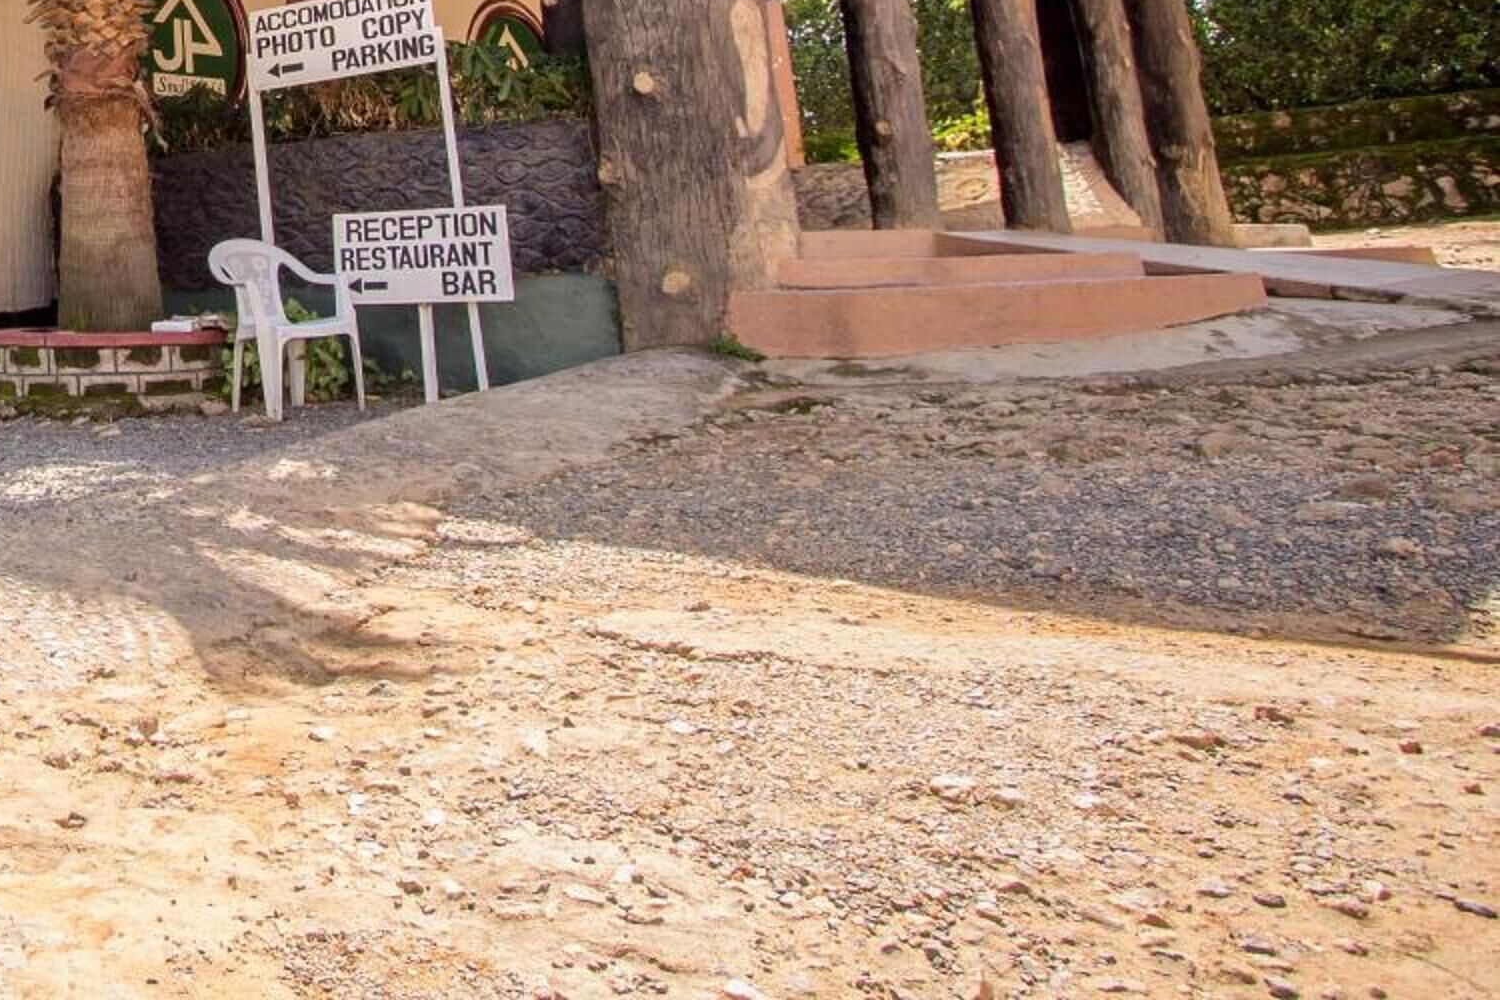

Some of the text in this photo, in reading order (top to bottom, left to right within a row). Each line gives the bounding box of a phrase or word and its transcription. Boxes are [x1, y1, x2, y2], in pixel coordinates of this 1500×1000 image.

[257, 8, 426, 59] PHOTO COPY
[331, 34, 435, 72] PARKING
[345, 212, 497, 243] RECEPTION
[340, 241, 493, 272] RESTAURANT
[441, 270, 497, 296] BAR
